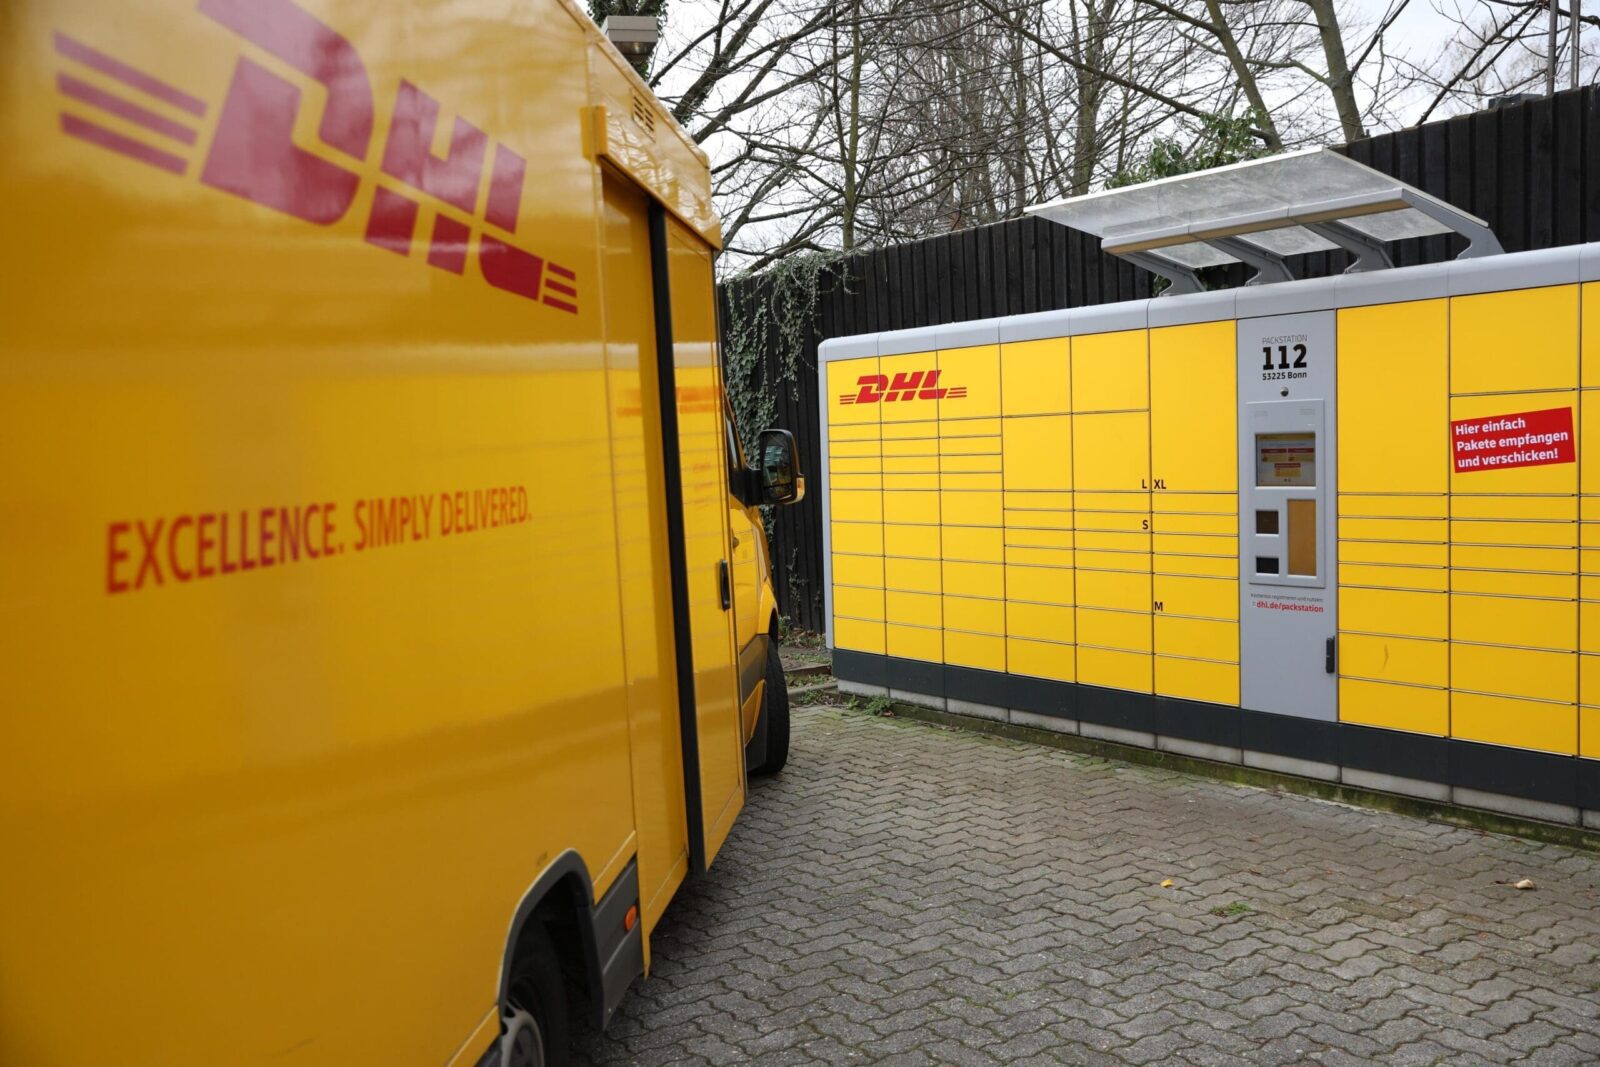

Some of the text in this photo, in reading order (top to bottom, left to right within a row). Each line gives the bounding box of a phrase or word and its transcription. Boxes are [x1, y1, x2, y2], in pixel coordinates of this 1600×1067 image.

[198, 0, 546, 302] DHL
[1262, 334, 1308, 344] PACKSTATION
[1263, 344, 1307, 370] 112
[1262, 371, 1307, 381] 53225 Bonn
[855, 369, 949, 404] DHL
[1455, 418, 1525, 435] Hier einfach
[1456, 432, 1568, 451] Pakete empfangen
[1458, 448, 1558, 468] und verschicken!
[1142, 479, 1148, 489] L
[1154, 479, 1166, 489] XL
[1142, 520, 1148, 530] S
[105, 484, 532, 595] EXCELLENCE. SIMPLY DELIVERED.
[1154, 601, 1163, 612] M
[1256, 600, 1324, 612] dhl.de/packstation
